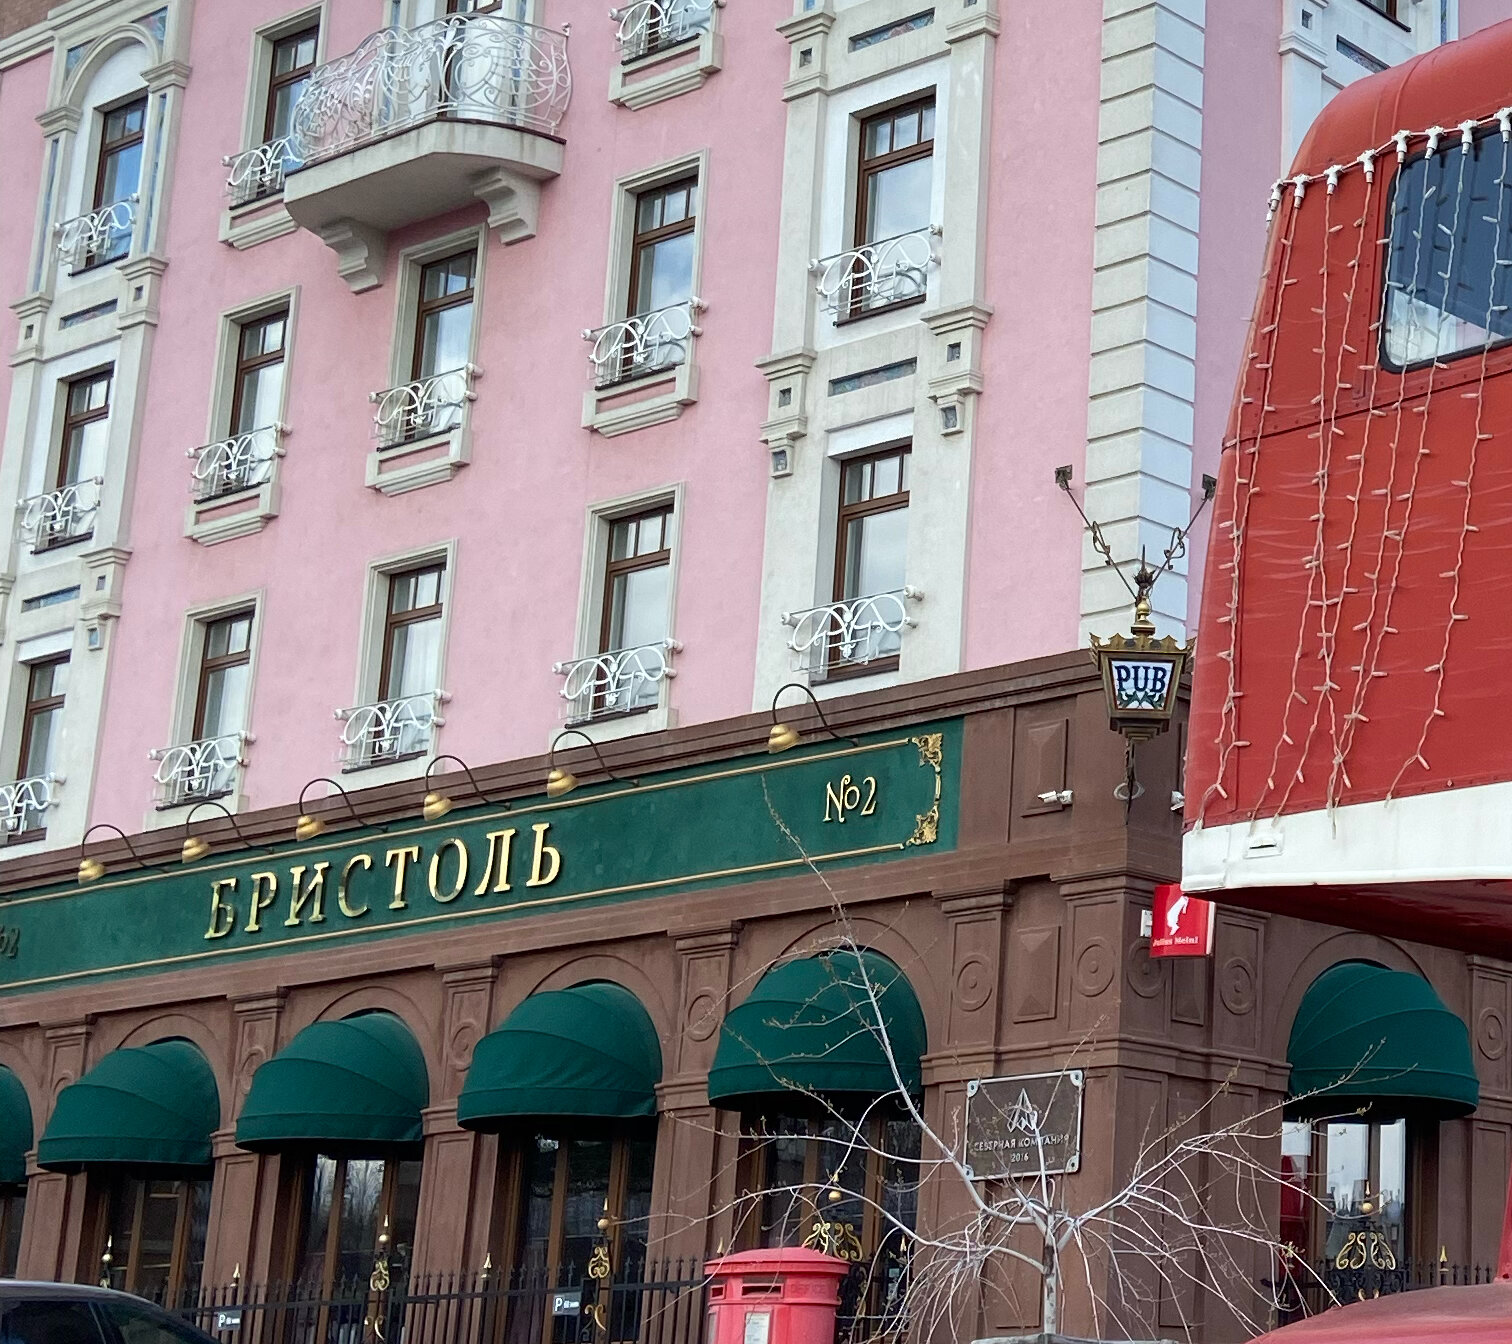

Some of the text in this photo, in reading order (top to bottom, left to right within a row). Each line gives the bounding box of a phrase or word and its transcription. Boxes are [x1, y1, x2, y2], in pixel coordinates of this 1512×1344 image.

[1114, 665, 1167, 693] PUB
[204, 822, 562, 940] БРИСТОЛЬ
[1010, 1152, 1029, 1163] 2016
